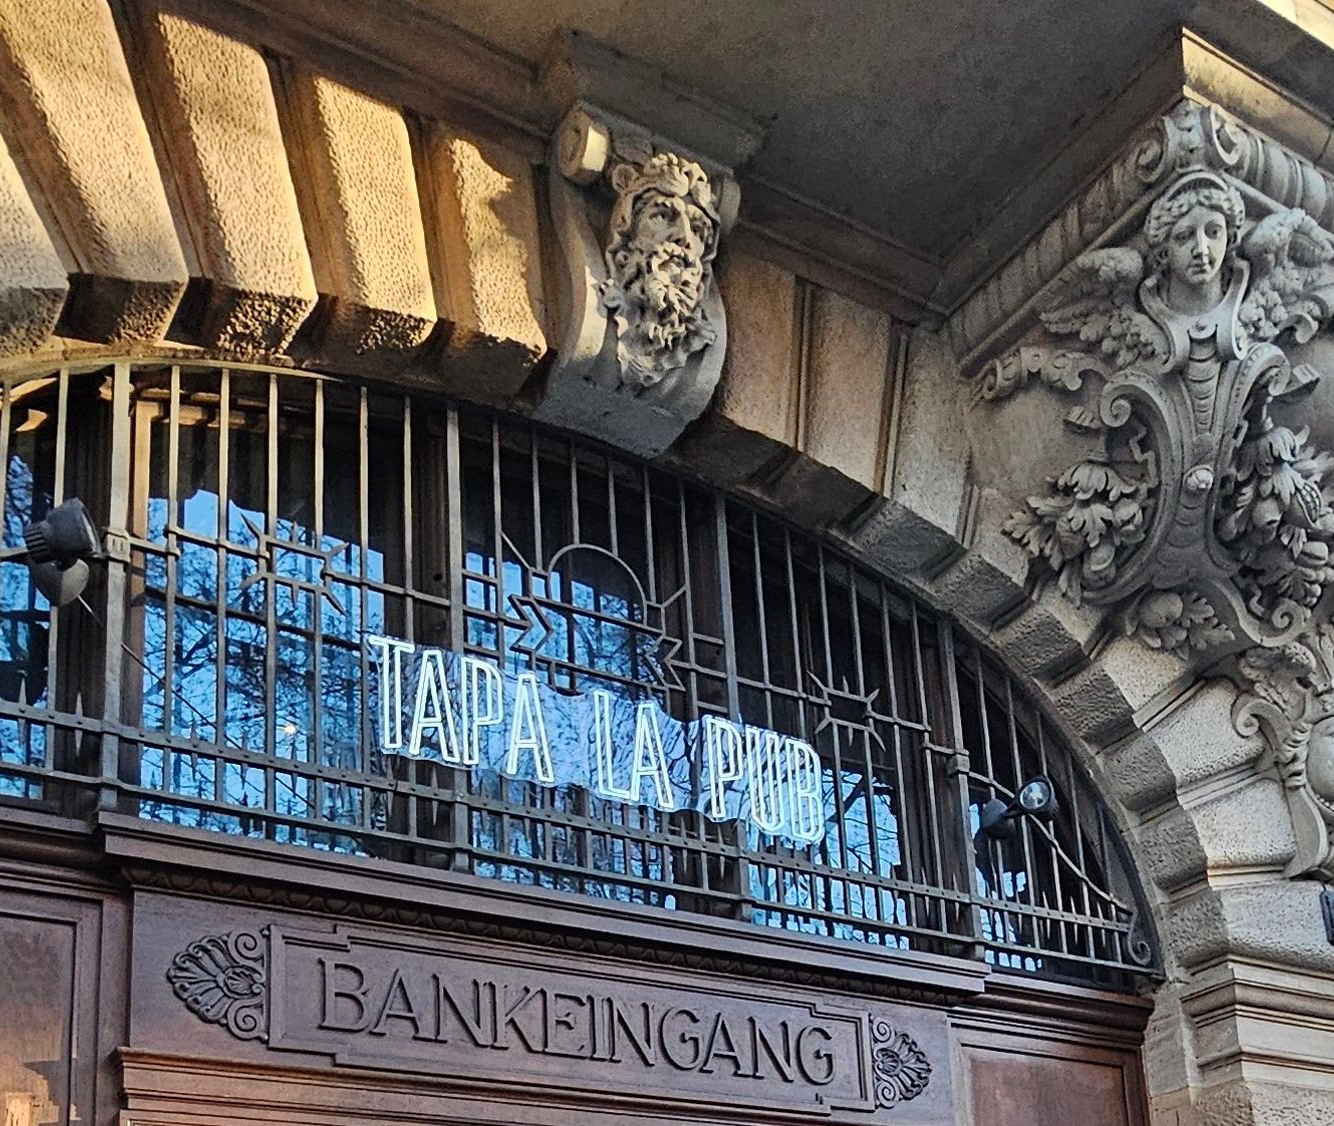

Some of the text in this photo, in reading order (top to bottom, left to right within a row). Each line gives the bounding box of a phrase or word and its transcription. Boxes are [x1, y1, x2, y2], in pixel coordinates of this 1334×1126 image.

[369, 635, 825, 844] TAPA LA PUB
[317, 956, 836, 1086] BANKEINGANG
